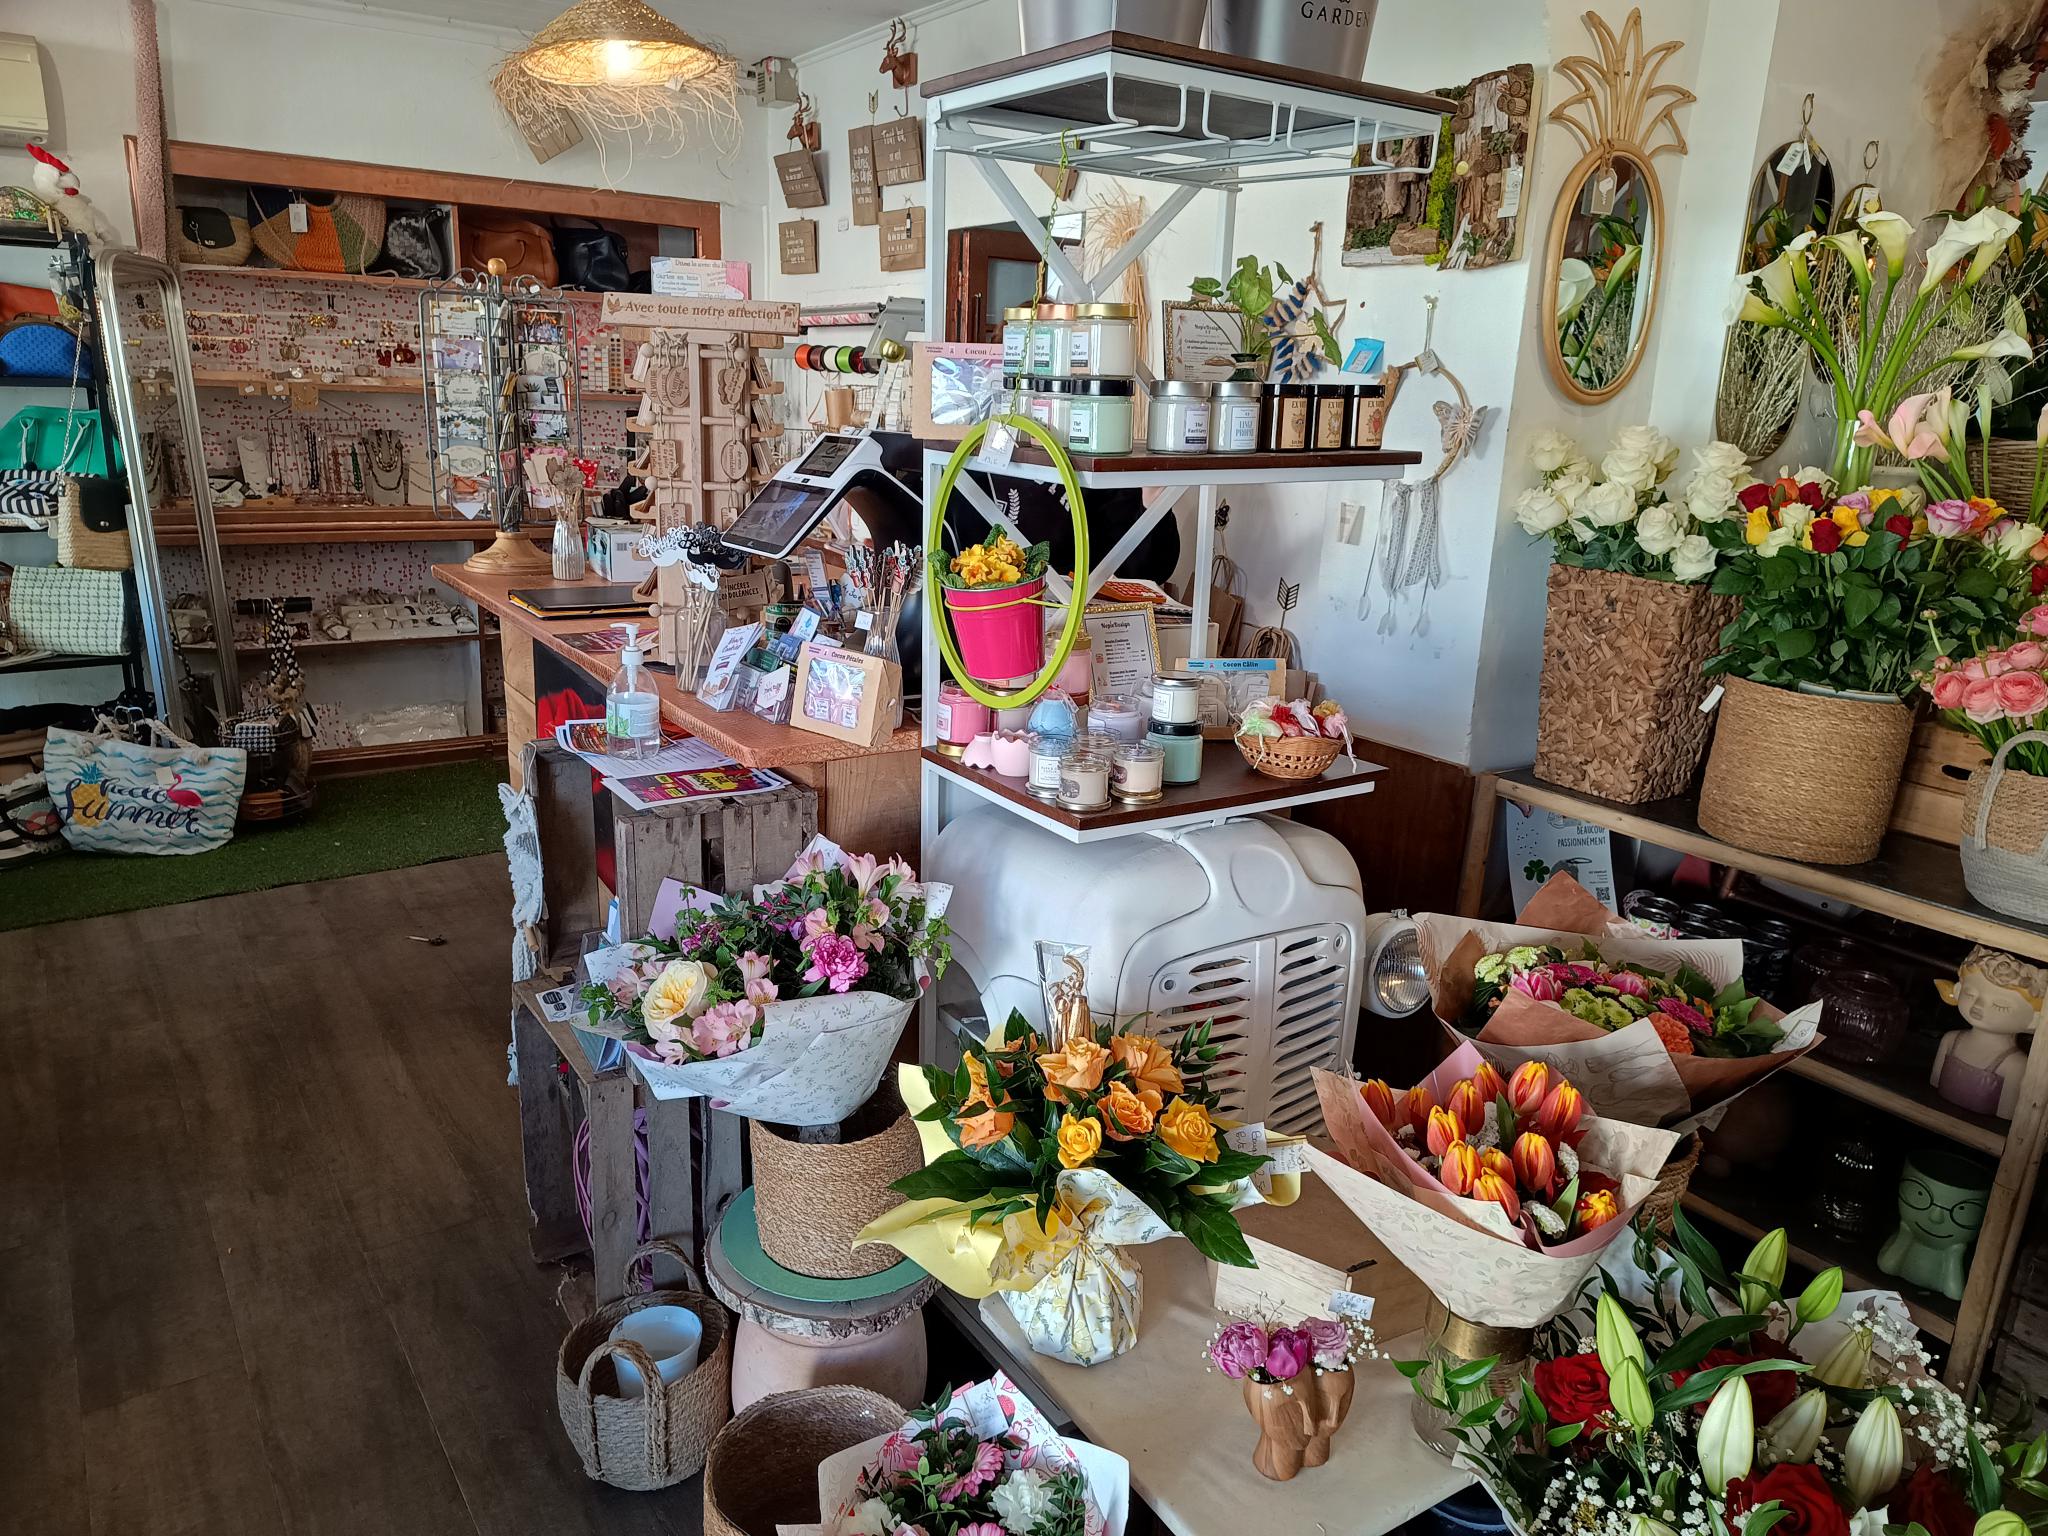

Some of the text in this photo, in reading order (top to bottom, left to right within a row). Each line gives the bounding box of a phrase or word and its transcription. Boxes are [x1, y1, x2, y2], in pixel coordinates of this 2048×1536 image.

[1301, 1, 1369, 27] GARDEN
[625, 301, 781, 320] Avec toute notre affection
[831, 651, 864, 664] Cocon Pétales
[1243, 660, 1259, 668] Câlin
